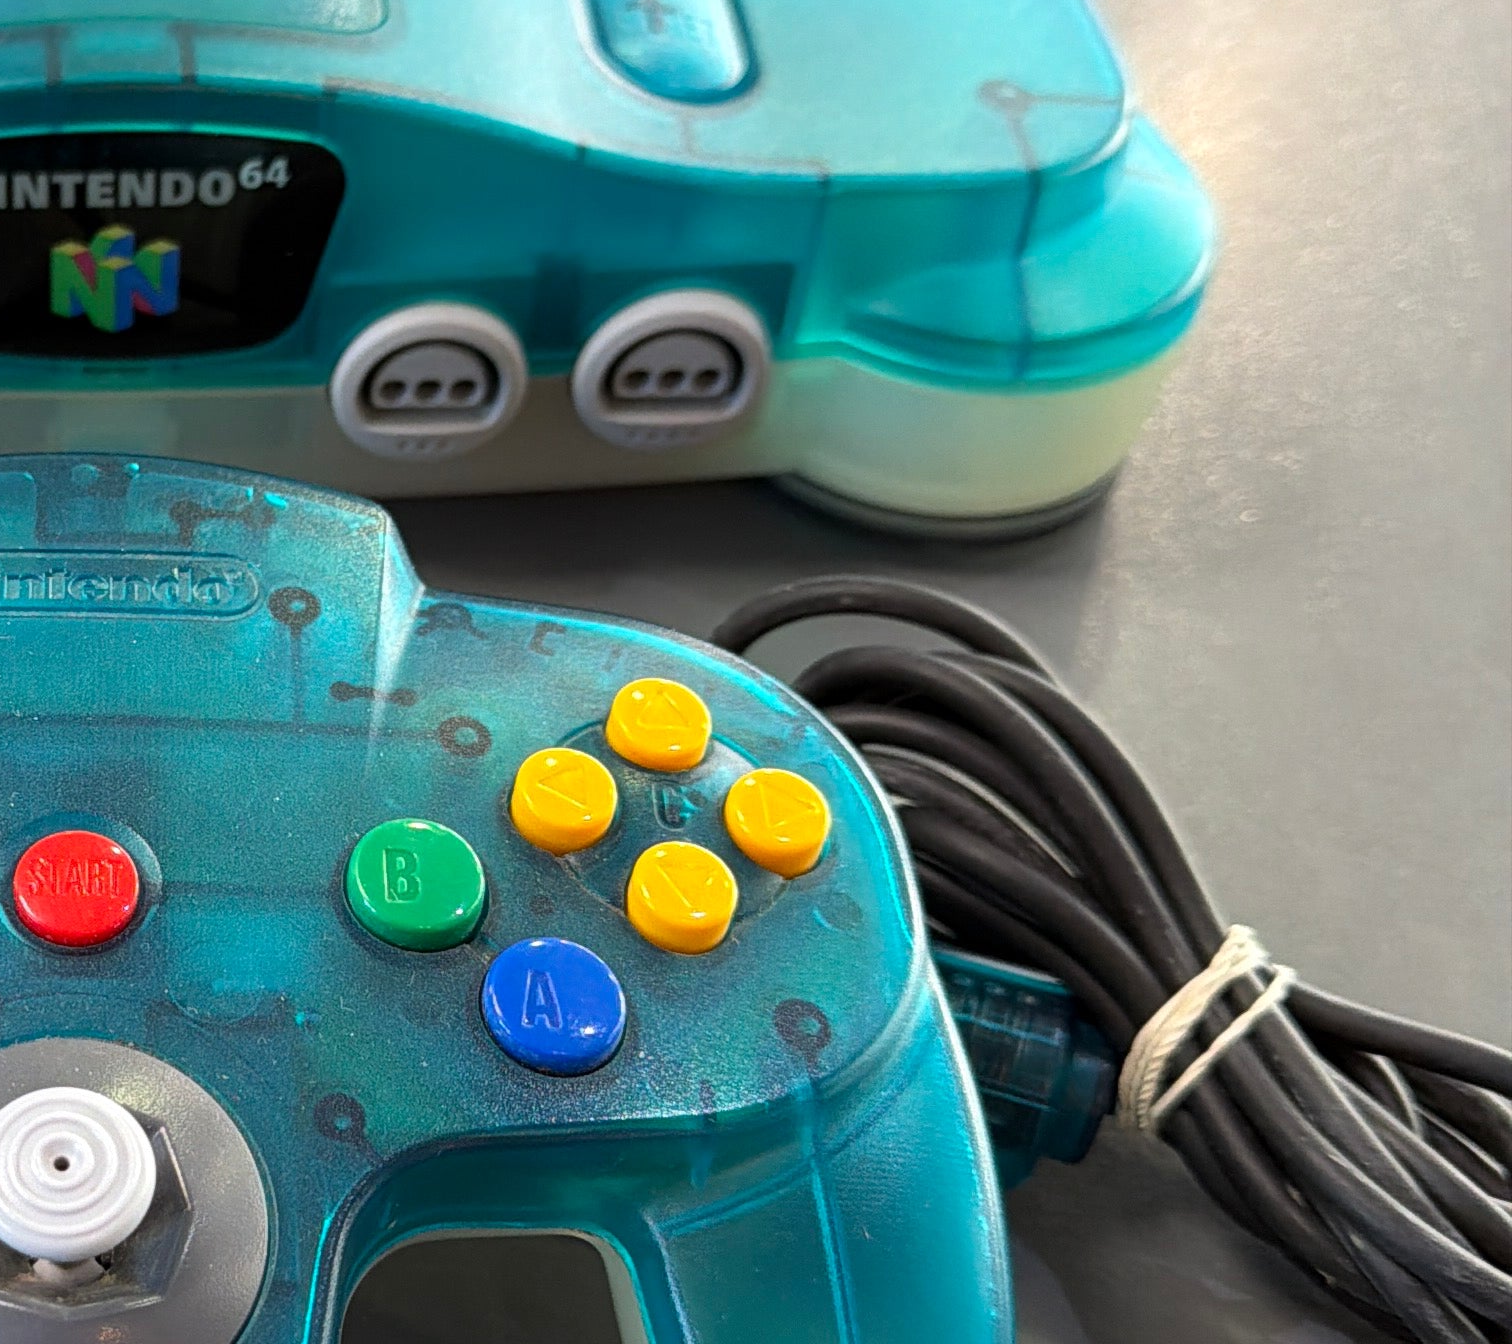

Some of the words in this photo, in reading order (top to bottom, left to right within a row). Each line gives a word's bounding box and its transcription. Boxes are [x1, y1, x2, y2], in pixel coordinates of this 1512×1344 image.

[26, 857, 124, 898] START
[382, 845, 421, 904] B
[520, 969, 562, 1030] A
